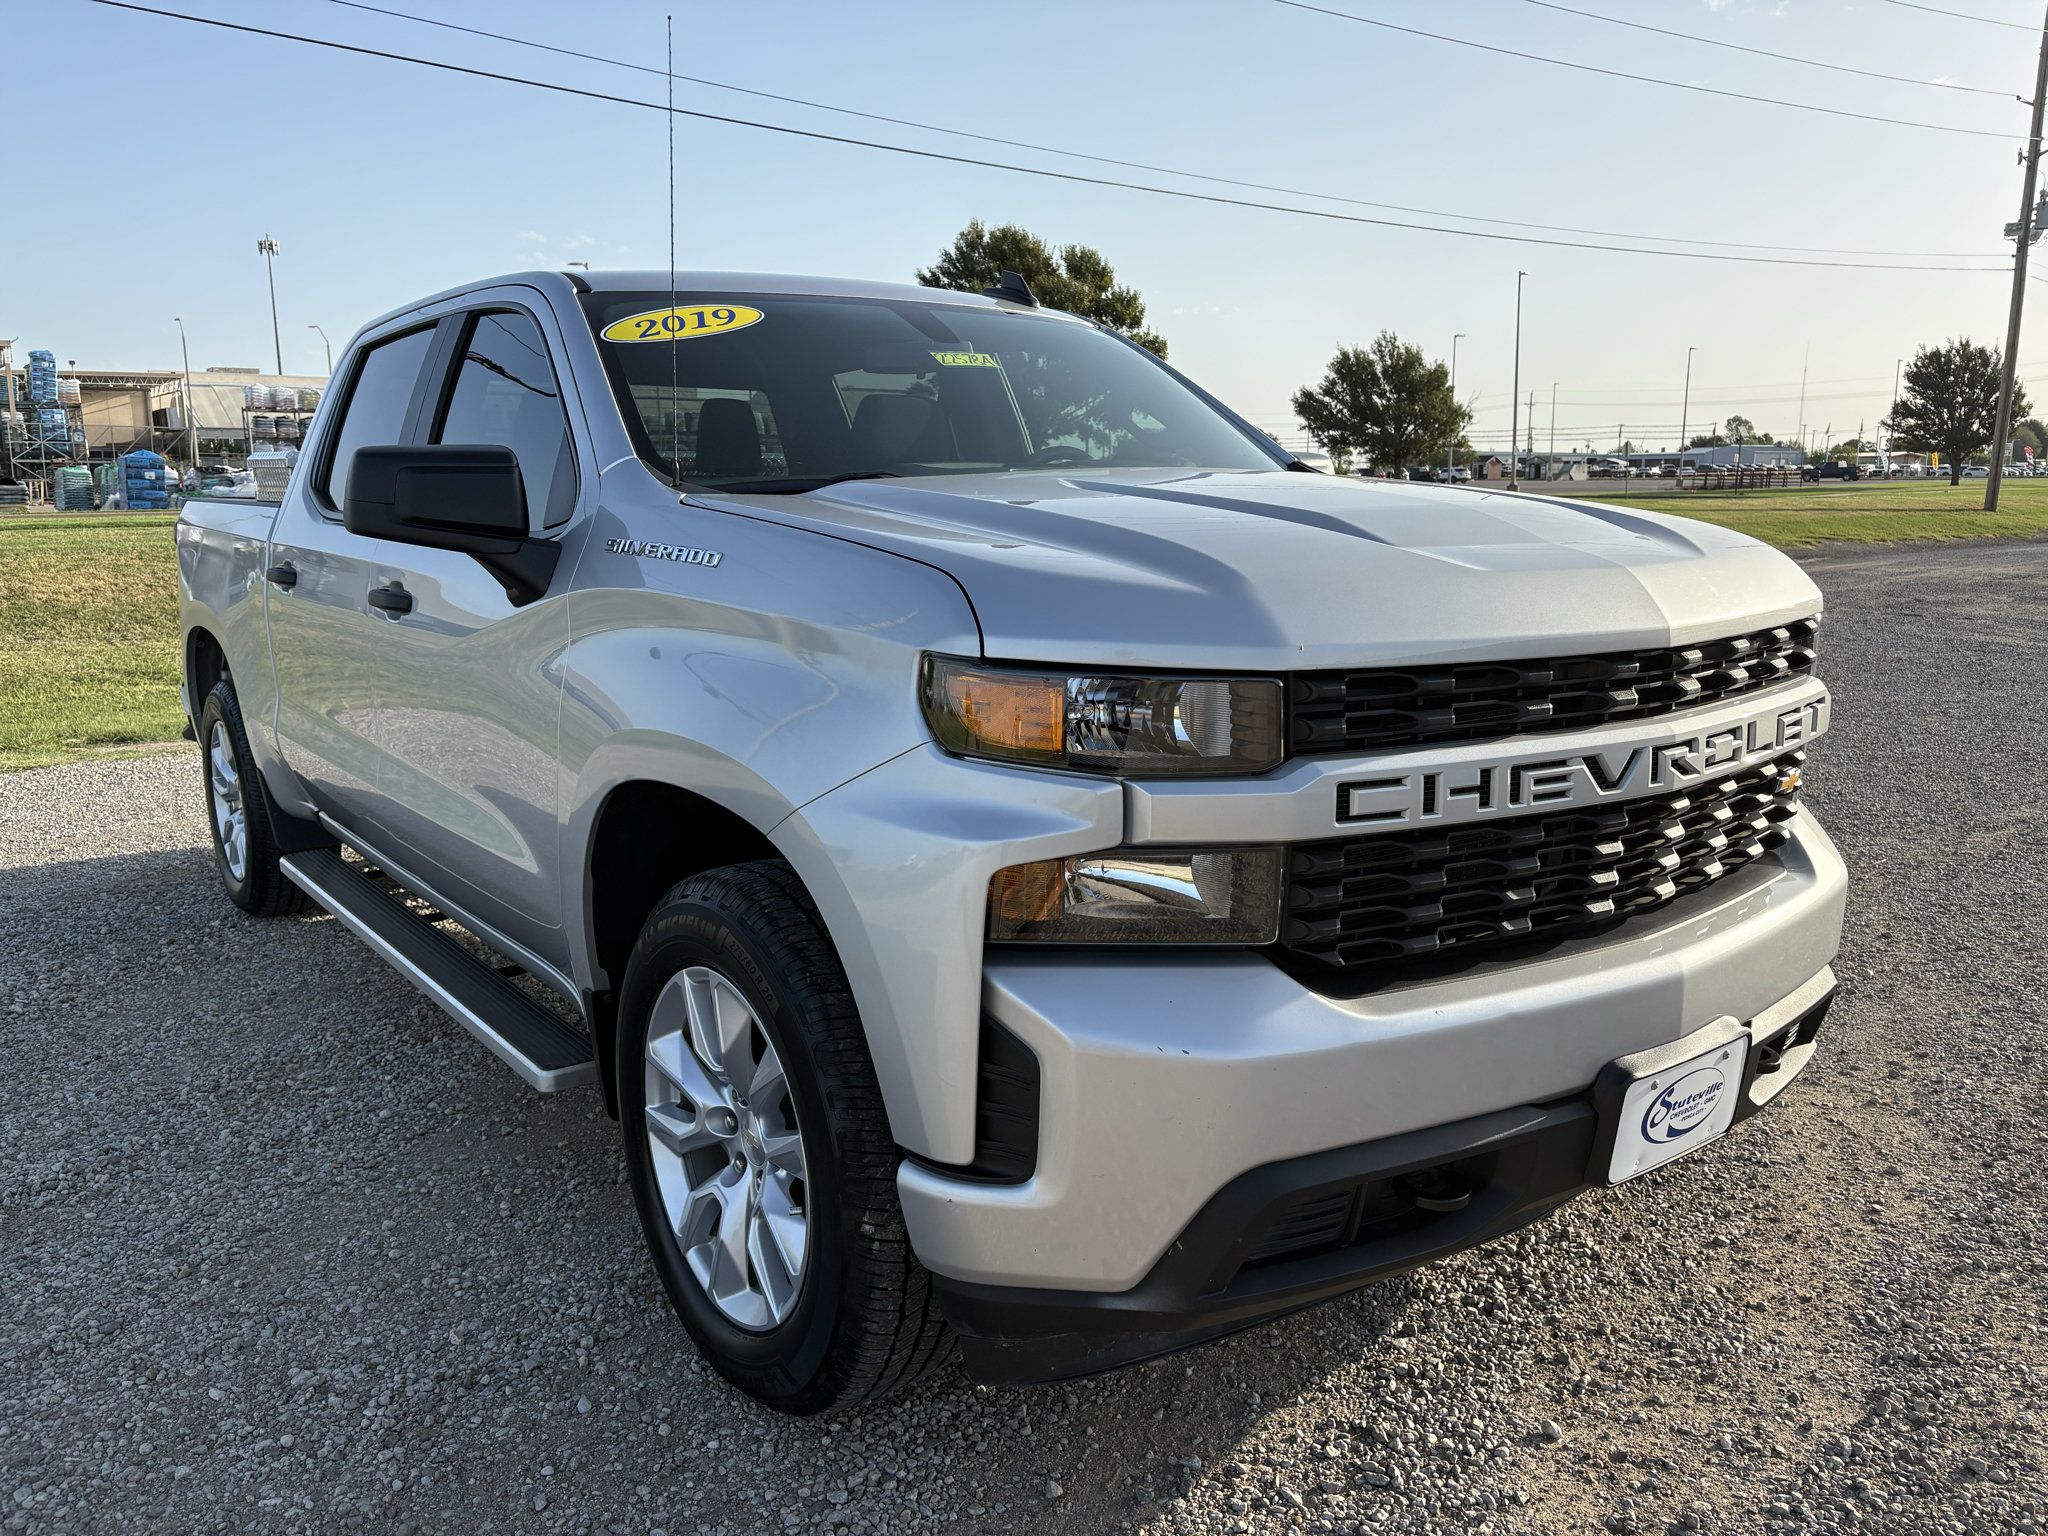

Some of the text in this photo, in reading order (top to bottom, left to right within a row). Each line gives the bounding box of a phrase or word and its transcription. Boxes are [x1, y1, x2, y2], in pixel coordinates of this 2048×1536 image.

[635, 308, 736, 339] 2019
[604, 538, 723, 568] SILVERADO
[1334, 700, 1828, 827] CHEVROLET
[1650, 1081, 1724, 1128] Stuteville
[1670, 1101, 1700, 1120] CHEVROLET
